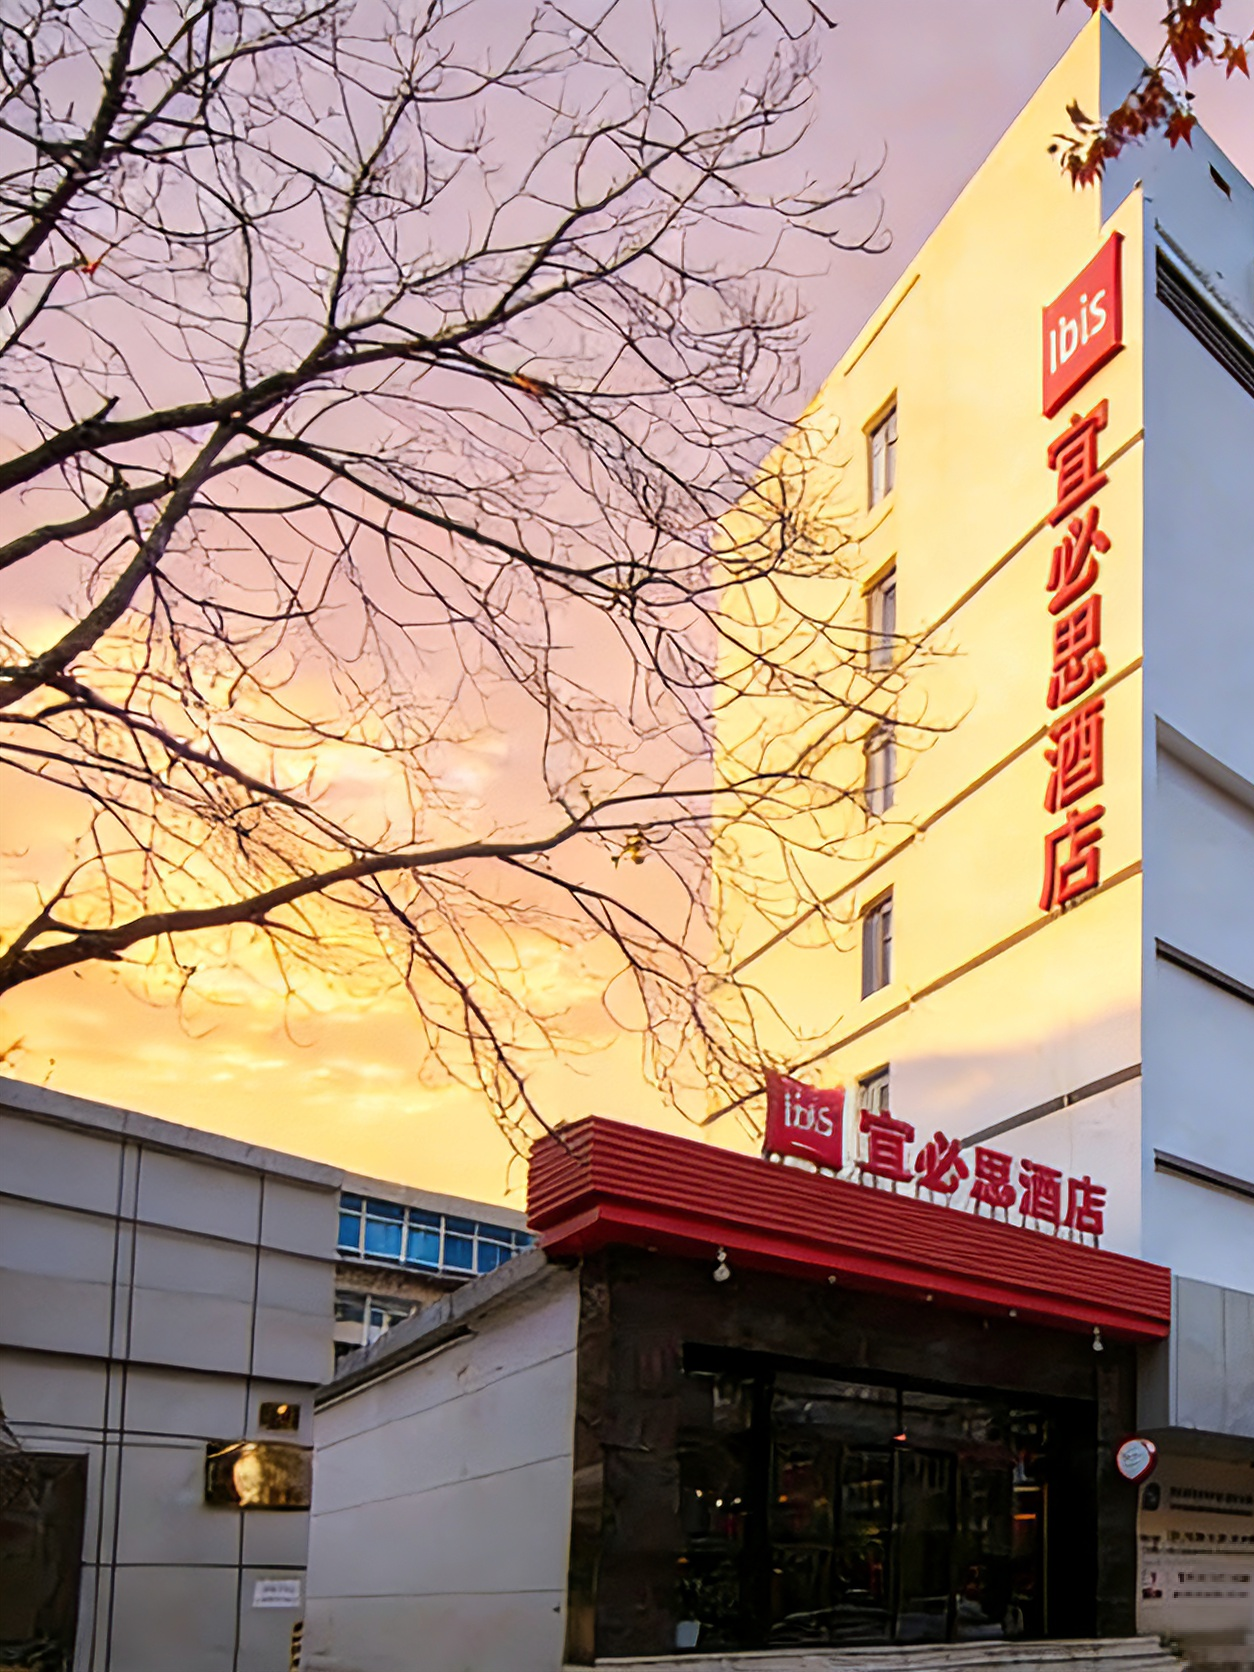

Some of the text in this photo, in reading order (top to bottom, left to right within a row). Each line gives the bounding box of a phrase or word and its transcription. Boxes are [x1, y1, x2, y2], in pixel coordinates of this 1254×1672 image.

[1039, 398, 1110, 912] 宜必思酒店
[858, 1108, 1107, 1235] 宜必思酒店
